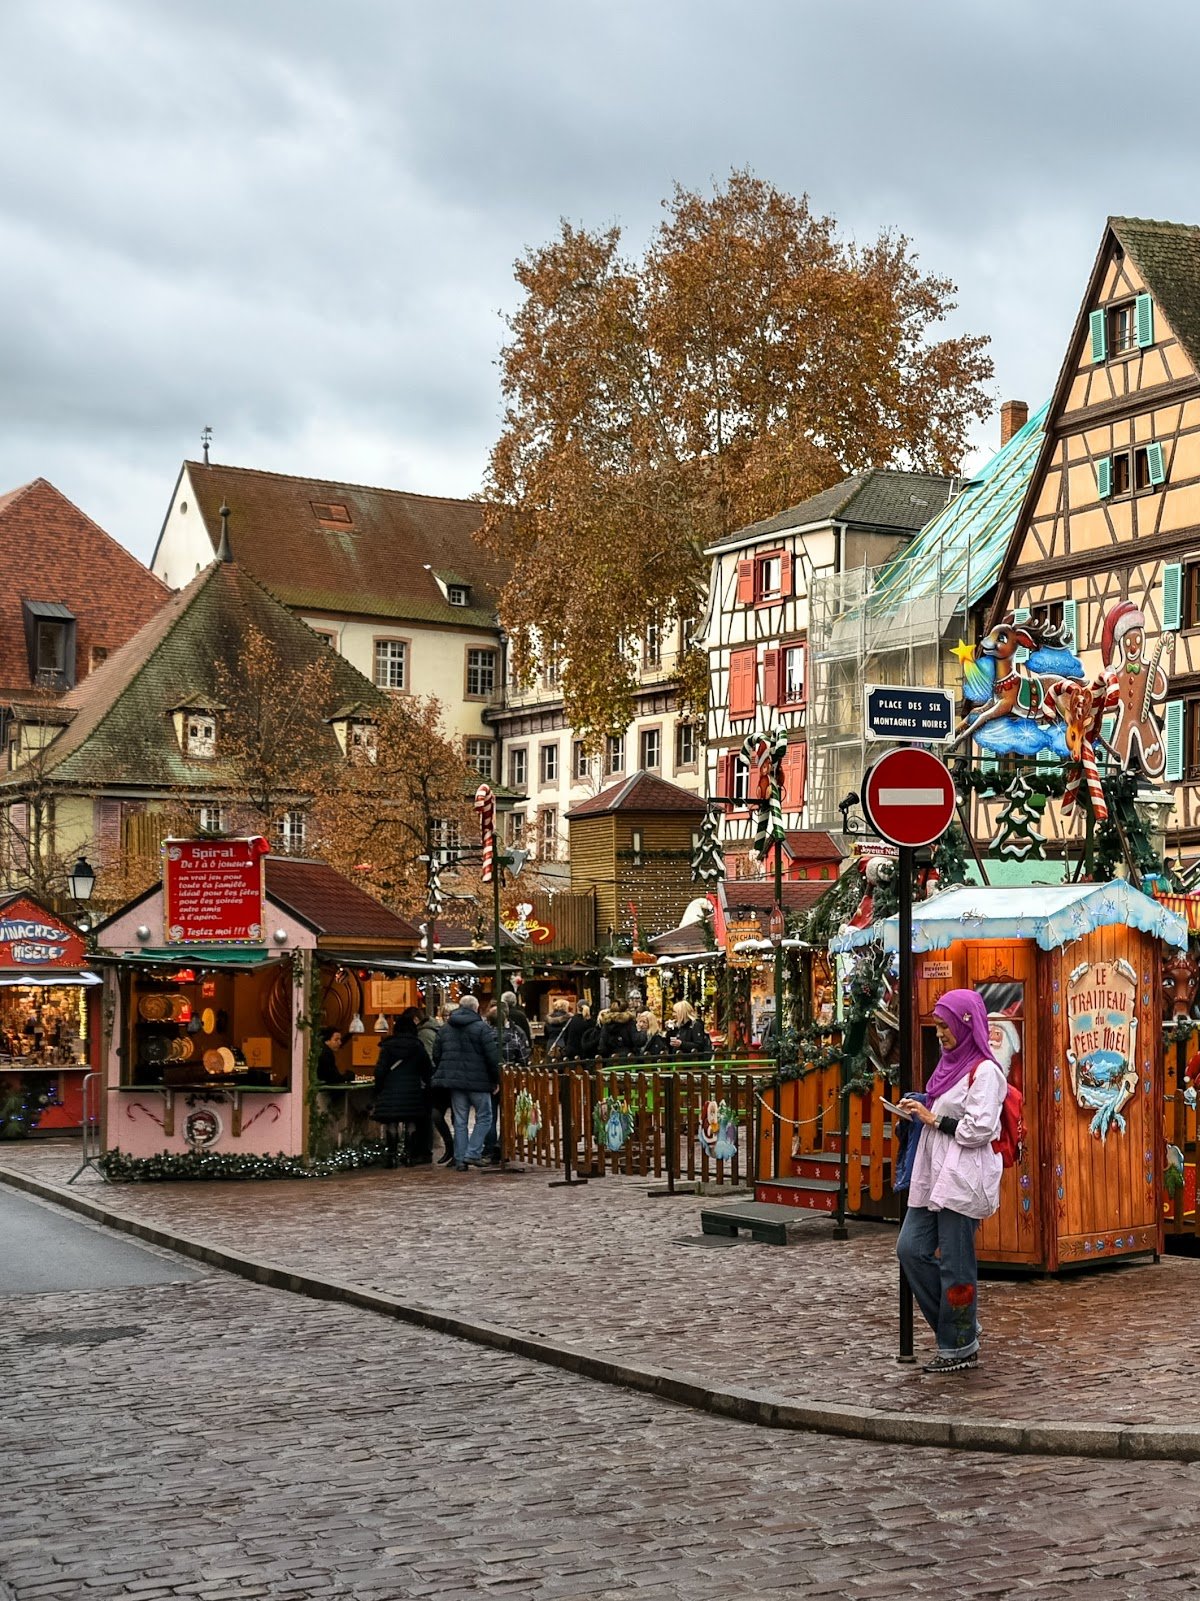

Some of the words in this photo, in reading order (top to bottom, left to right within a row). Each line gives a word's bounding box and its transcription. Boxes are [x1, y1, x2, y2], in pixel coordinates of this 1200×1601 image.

[879, 700, 902, 709] PLACE
[908, 702, 922, 710] DES
[929, 703, 941, 711] SIX
[873, 717, 917, 727] MONTAGNES
[922, 720, 947, 729] NOIRES
[192, 848, 234, 860] Spiral
[180, 860, 193, 869] De
[201, 860, 208, 868] à
[178, 881, 200, 889] toute
[214, 881, 247, 890] famille
[178, 889, 201, 897] idéal
[202, 890, 223, 898] pour
[239, 888, 260, 896] fêtes
[178, 898, 198, 906] pour
[199, 897, 214, 905] les
[215, 897, 244, 905] soirées
[187, 927, 213, 937] Testez
[214, 926, 232, 936] moi
[233, 926, 246, 935] !!!
[1096, 968, 1107, 986] LE
[1071, 989, 1127, 1015] TRAINEAU
[1095, 1012, 1105, 1026] du
[1103, 1026, 1126, 1054] NOËL
